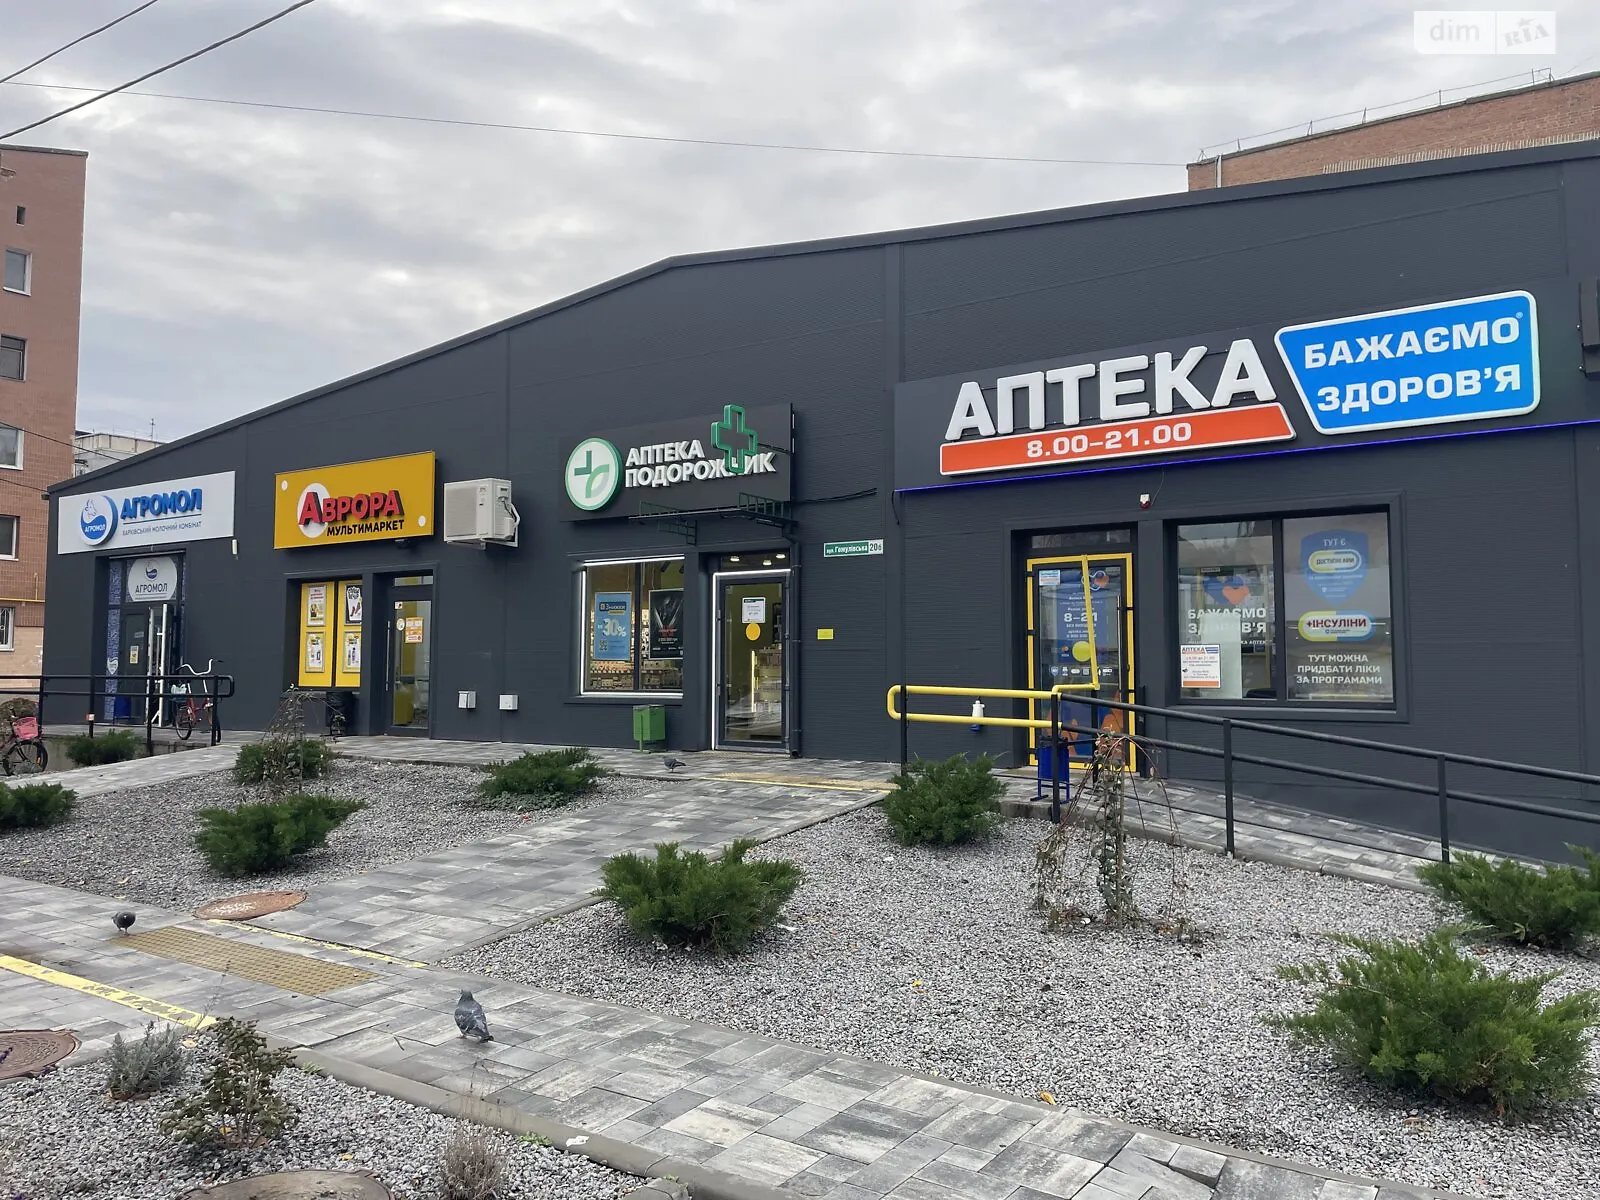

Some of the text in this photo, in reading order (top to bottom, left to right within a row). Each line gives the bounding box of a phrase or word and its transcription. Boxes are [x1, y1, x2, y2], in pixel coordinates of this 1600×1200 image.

[1304, 315, 1520, 369] БАЖАЄМО
[944, 338, 1278, 441] АПТЕКА
[1317, 364, 1521, 414] ЗДОРОВ’Я
[625, 439, 705, 467] АПТЕКА
[120, 488, 203, 520] АГРОМОЛ
[84, 523, 107, 533] АГРОМОЛ
[326, 519, 405, 537] МУЛЬТИМАРКЕТ
[1323, 538, 1338, 547] ТУТ
[135, 582, 168, 593] АГРОМОЛ
[1306, 618, 1367, 628] +ІНСУЛІНИ
[1308, 654, 1369, 662] ТУТ МОЖНА
[1297, 665, 1381, 674] ПРИДБАТИ ЛІКИ
[1296, 676, 1382, 684] ЗА ПРОГРАМАМИ
